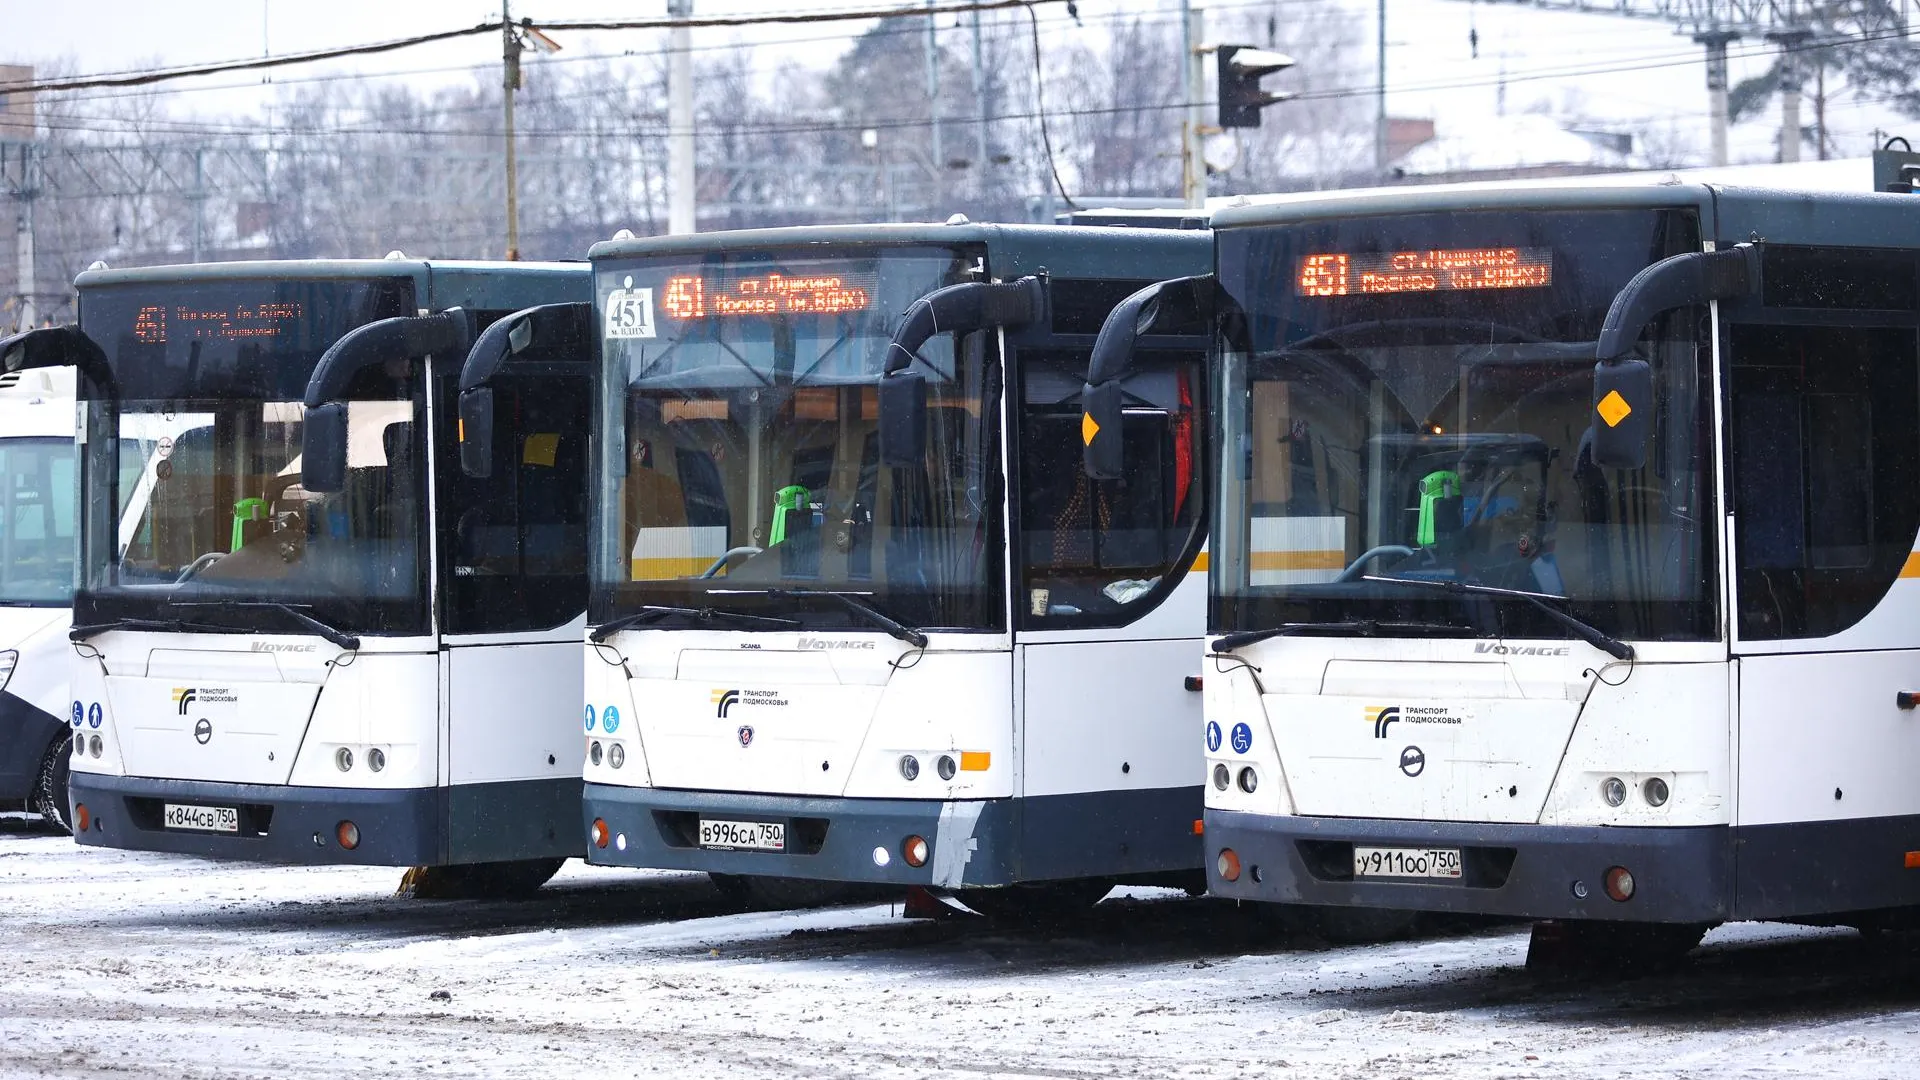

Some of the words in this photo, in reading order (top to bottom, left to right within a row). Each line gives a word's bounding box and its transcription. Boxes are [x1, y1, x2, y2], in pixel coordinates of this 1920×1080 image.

[1302, 255, 1347, 296] 451
[664, 277, 704, 317] 451
[611, 300, 648, 327] 451
[136, 305, 166, 343] 451
[251, 641, 317, 653] VOYAGE
[797, 638, 876, 650] VOYAGE
[1473, 641, 1570, 656] VOYAGE
[742, 698, 789, 706] ПОДМОСКОВЬЯ
[1405, 706, 1448, 715] ТРАНСПОРТ
[1405, 715, 1462, 725] ПОДМОСКОВЬЯ
[216, 809, 234, 824] 750
[758, 824, 780, 840] 750
[1429, 851, 1456, 868] 750
